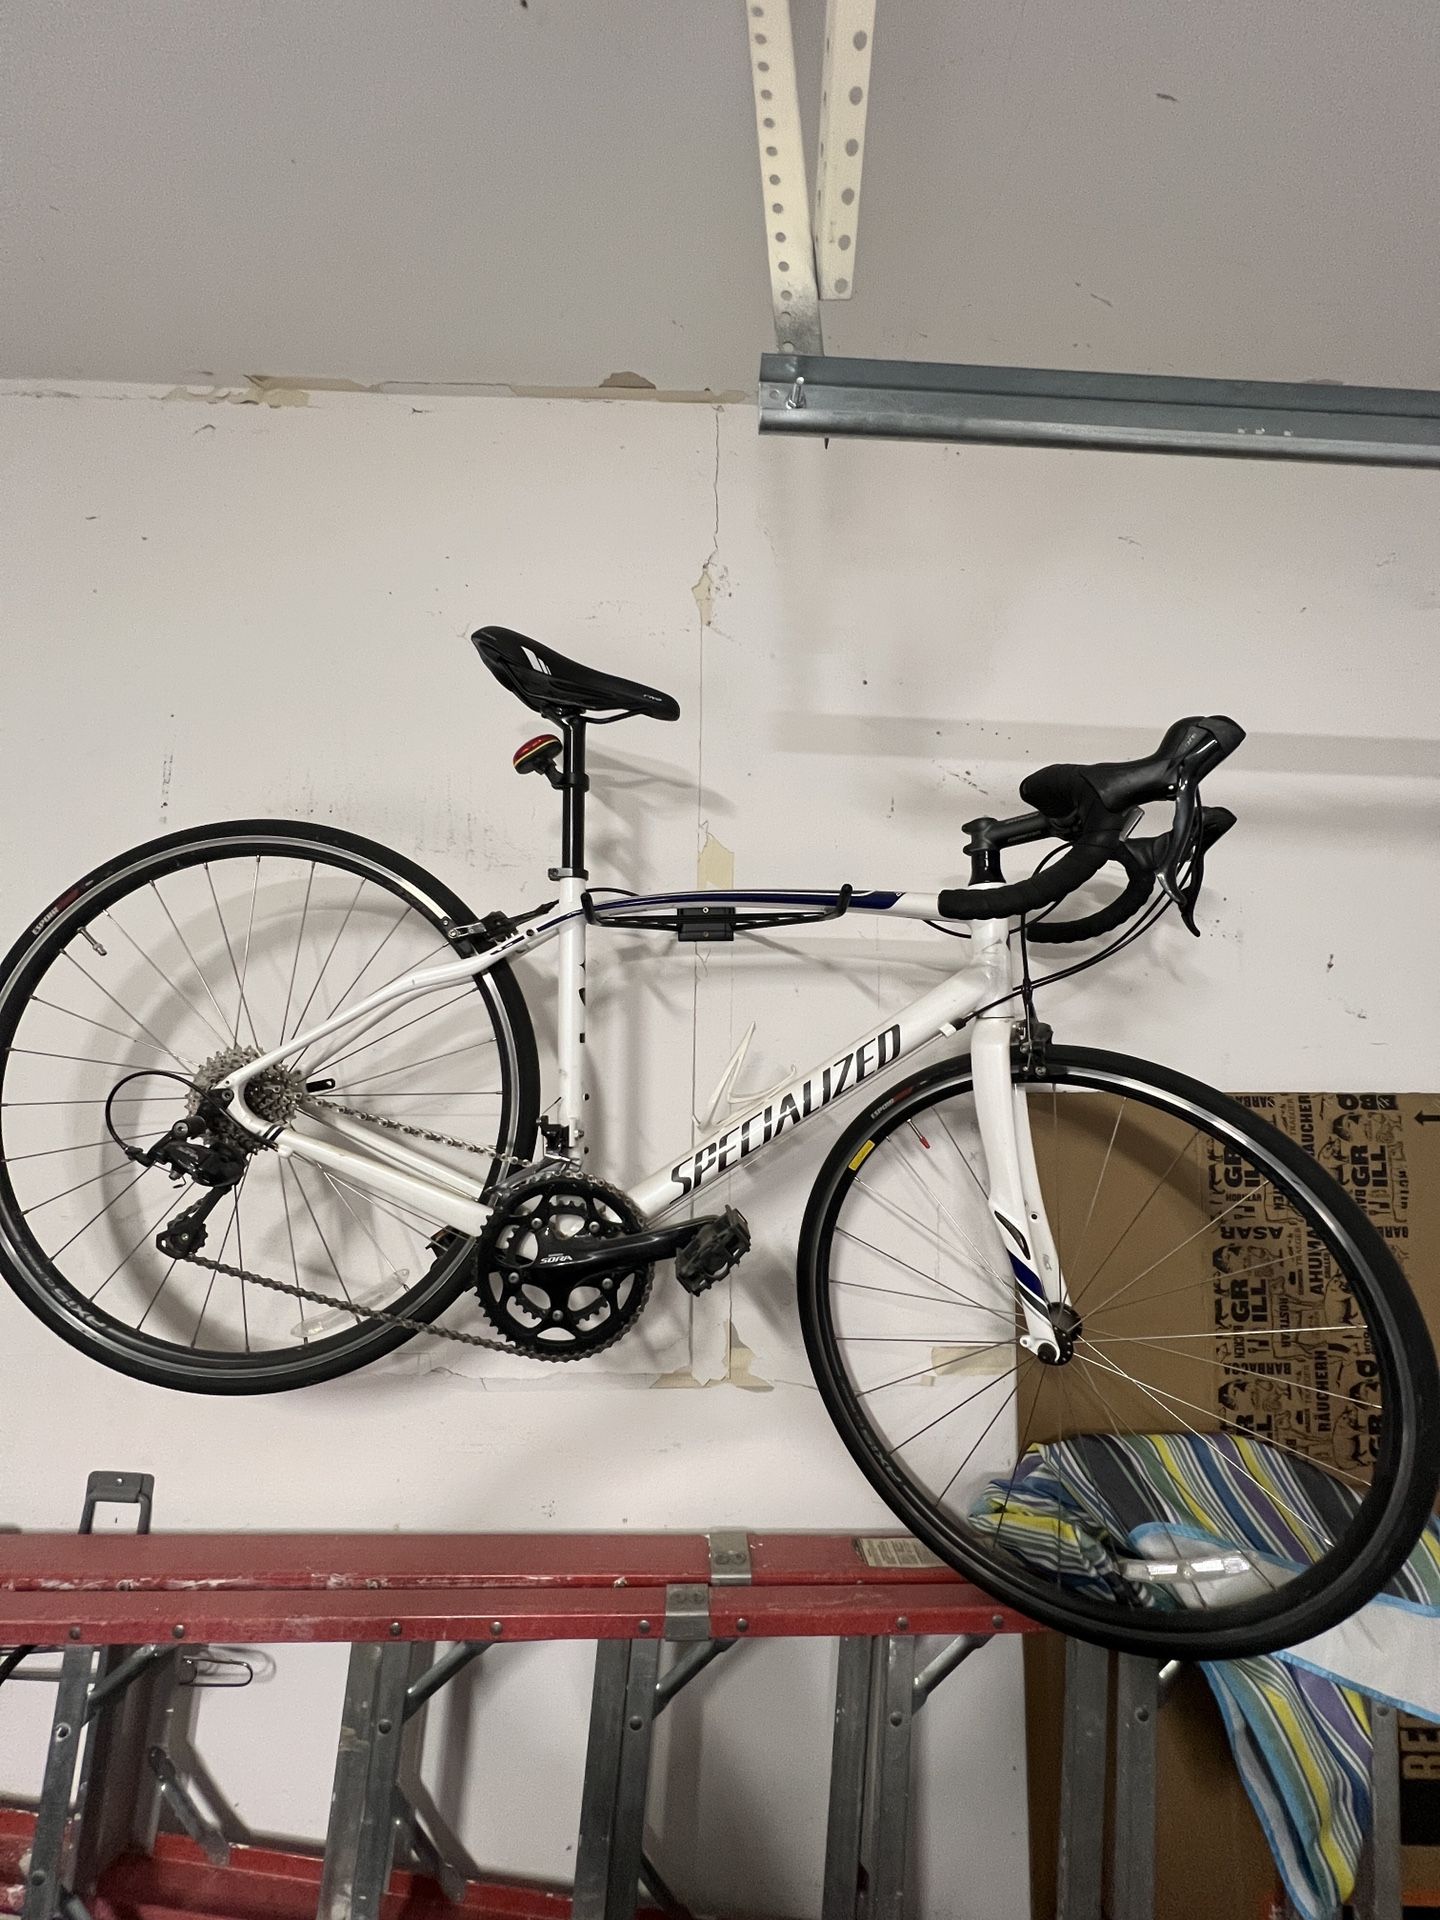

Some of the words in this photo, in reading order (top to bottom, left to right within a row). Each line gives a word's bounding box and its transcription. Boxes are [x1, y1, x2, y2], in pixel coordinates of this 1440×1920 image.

[670, 1023, 902, 1204] SPECIALIZED
[1351, 1145, 1370, 1187] GR
[1370, 1145, 1388, 1188] ILL
[1220, 1226, 1284, 1239] ASAR
[539, 1254, 573, 1264] SORA
[1230, 1278, 1250, 1323] GR
[1250, 1279, 1268, 1323] ILL
